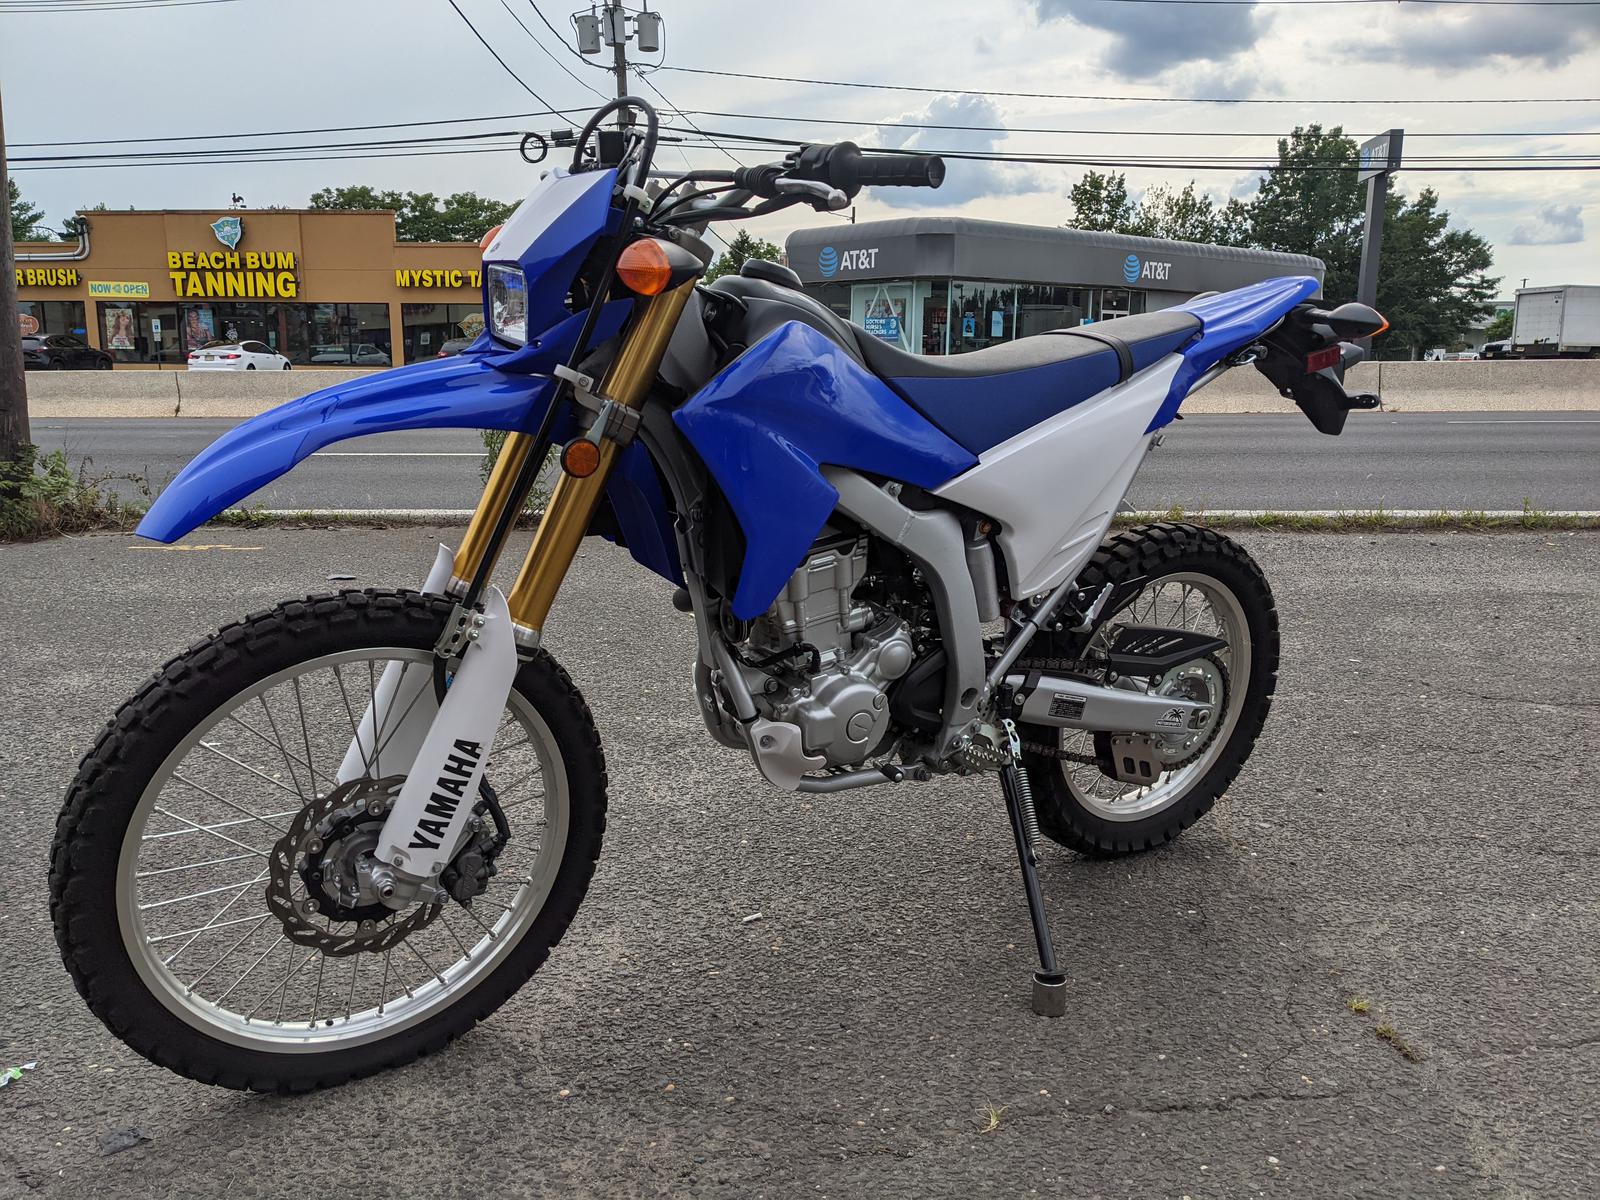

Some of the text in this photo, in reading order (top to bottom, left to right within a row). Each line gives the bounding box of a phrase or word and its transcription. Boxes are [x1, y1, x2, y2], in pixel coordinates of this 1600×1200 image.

[167, 251, 295, 269] BEACH BUM
[840, 248, 879, 271] AT&T
[26, 268, 78, 286] BRUSH
[395, 269, 463, 288] MYSTIC
[1141, 261, 1172, 280] AT&T
[90, 283, 148, 295] NOW OPEN
[169, 271, 297, 298] TANNING
[408, 739, 481, 850] YAMAHA
